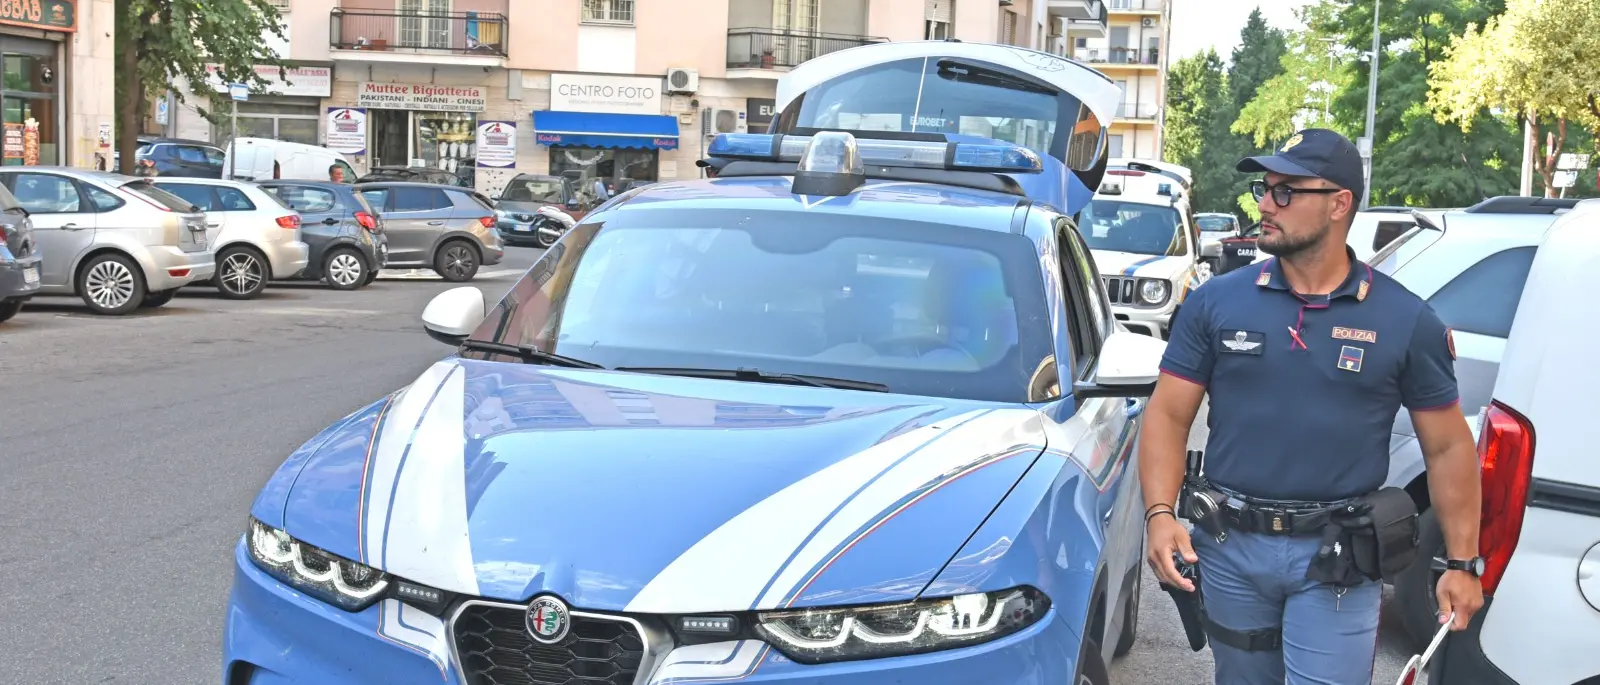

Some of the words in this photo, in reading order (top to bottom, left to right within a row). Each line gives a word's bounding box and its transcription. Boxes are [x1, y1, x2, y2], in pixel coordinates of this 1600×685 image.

[0, 0, 41, 21] EBAB
[365, 83, 409, 94] Muttee
[413, 85, 479, 97] Bigiotteria
[559, 84, 614, 98] CENTRO
[618, 87, 654, 99] FOTO
[360, 94, 405, 102] PAKISTANI
[413, 96, 448, 104] INDIANI
[910, 116, 946, 127] EUROBET
[538, 134, 561, 142] Kodak
[653, 138, 676, 147] Kodak
[1333, 328, 1374, 341] POLIZIA
[529, 603, 543, 619] ALFA
[545, 601, 566, 624] ROMEO
